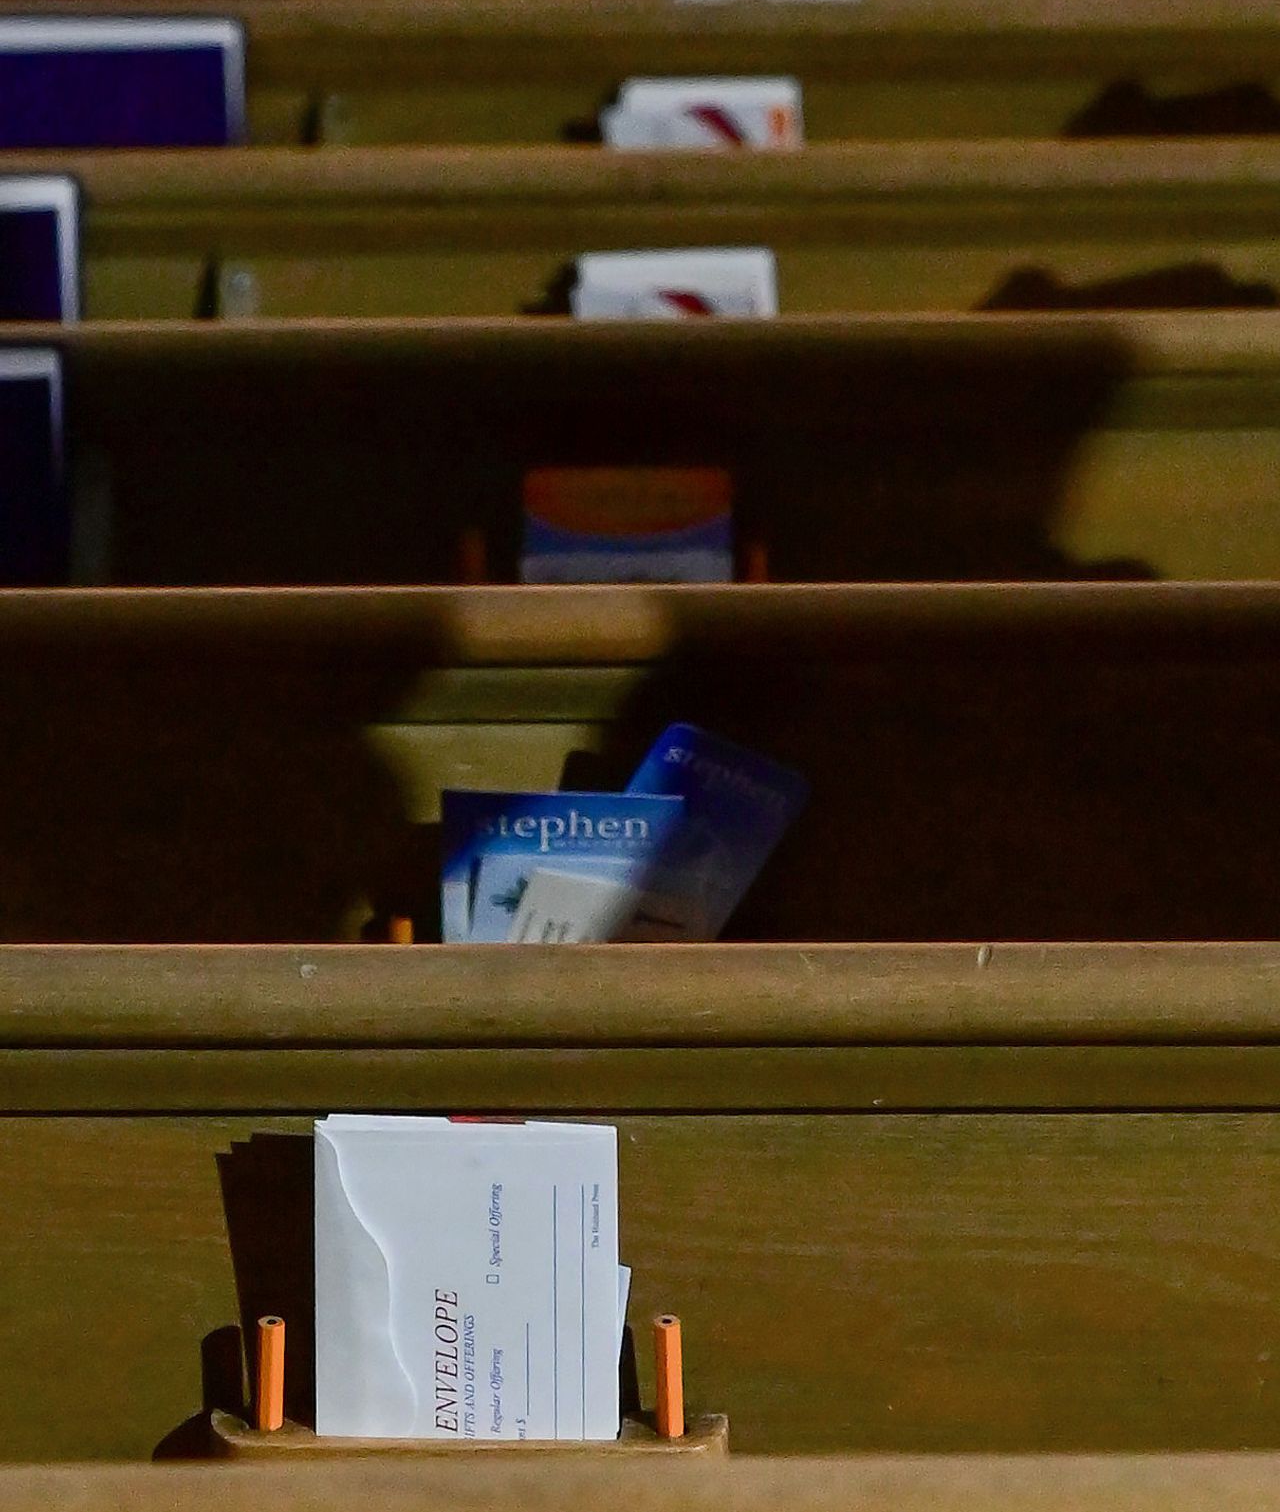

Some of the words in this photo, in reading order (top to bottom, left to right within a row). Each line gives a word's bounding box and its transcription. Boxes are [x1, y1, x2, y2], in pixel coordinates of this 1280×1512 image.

[489, 1182, 503, 1226] Offering
[489, 1230, 503, 1267] Special
[434, 1288, 458, 1433] ENVELOPE
[463, 1314, 475, 1382] OFFERINGS
[490, 1348, 504, 1390] Offering
[464, 1383, 475, 1409] AND
[490, 1393, 503, 1433] Regular
[464, 1412, 475, 1439] IFTS
